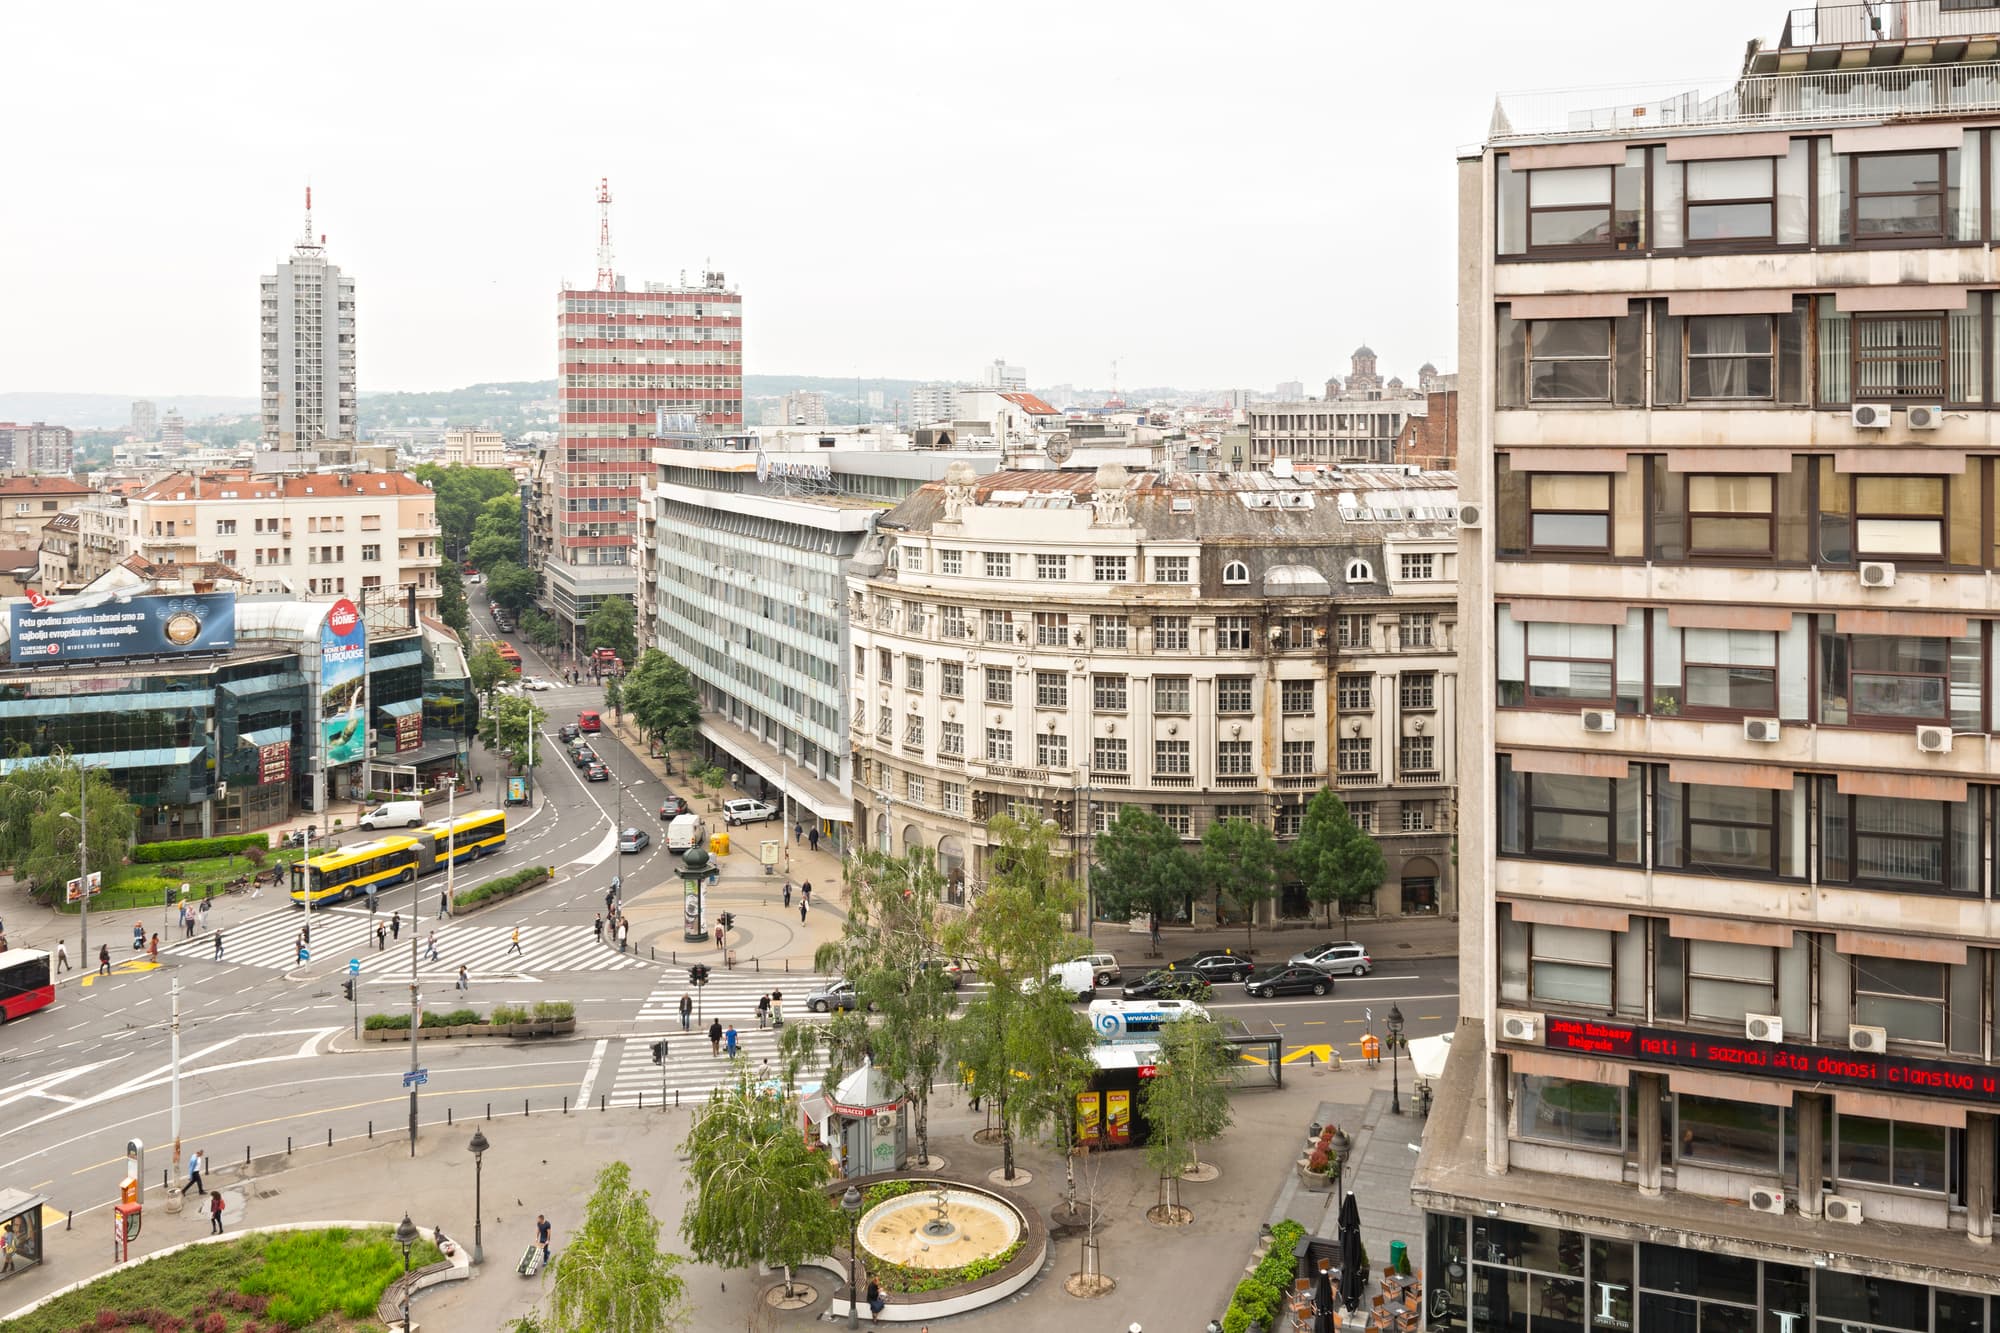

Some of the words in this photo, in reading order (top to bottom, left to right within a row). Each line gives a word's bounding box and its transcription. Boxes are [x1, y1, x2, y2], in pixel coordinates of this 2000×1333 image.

[19, 617, 36, 627] Petu
[37, 616, 62, 627] godinu
[62, 614, 92, 624] zaredom
[93, 613, 121, 623] izabrani
[121, 613, 136, 622] smo
[137, 612, 145, 620] za
[332, 613, 356, 626] HOME
[19, 630, 49, 641] najbolju
[49, 628, 81, 639] evropsku
[81, 625, 139, 637] avio-kompaniju.
[324, 648, 364, 662] TURQUOISE
[1586, 1024, 1633, 1042] Embassy
[1568, 1034, 1614, 1051] Belgrade
[1691, 1041, 1697, 1058] i
[1708, 1045, 1766, 1067] saznaj
[1817, 1056, 1877, 1079] donosi
[1889, 1066, 1975, 1090] clanstvo
[1983, 1077, 1996, 1093] u
[836, 1106, 864, 1116] TOBACCO
